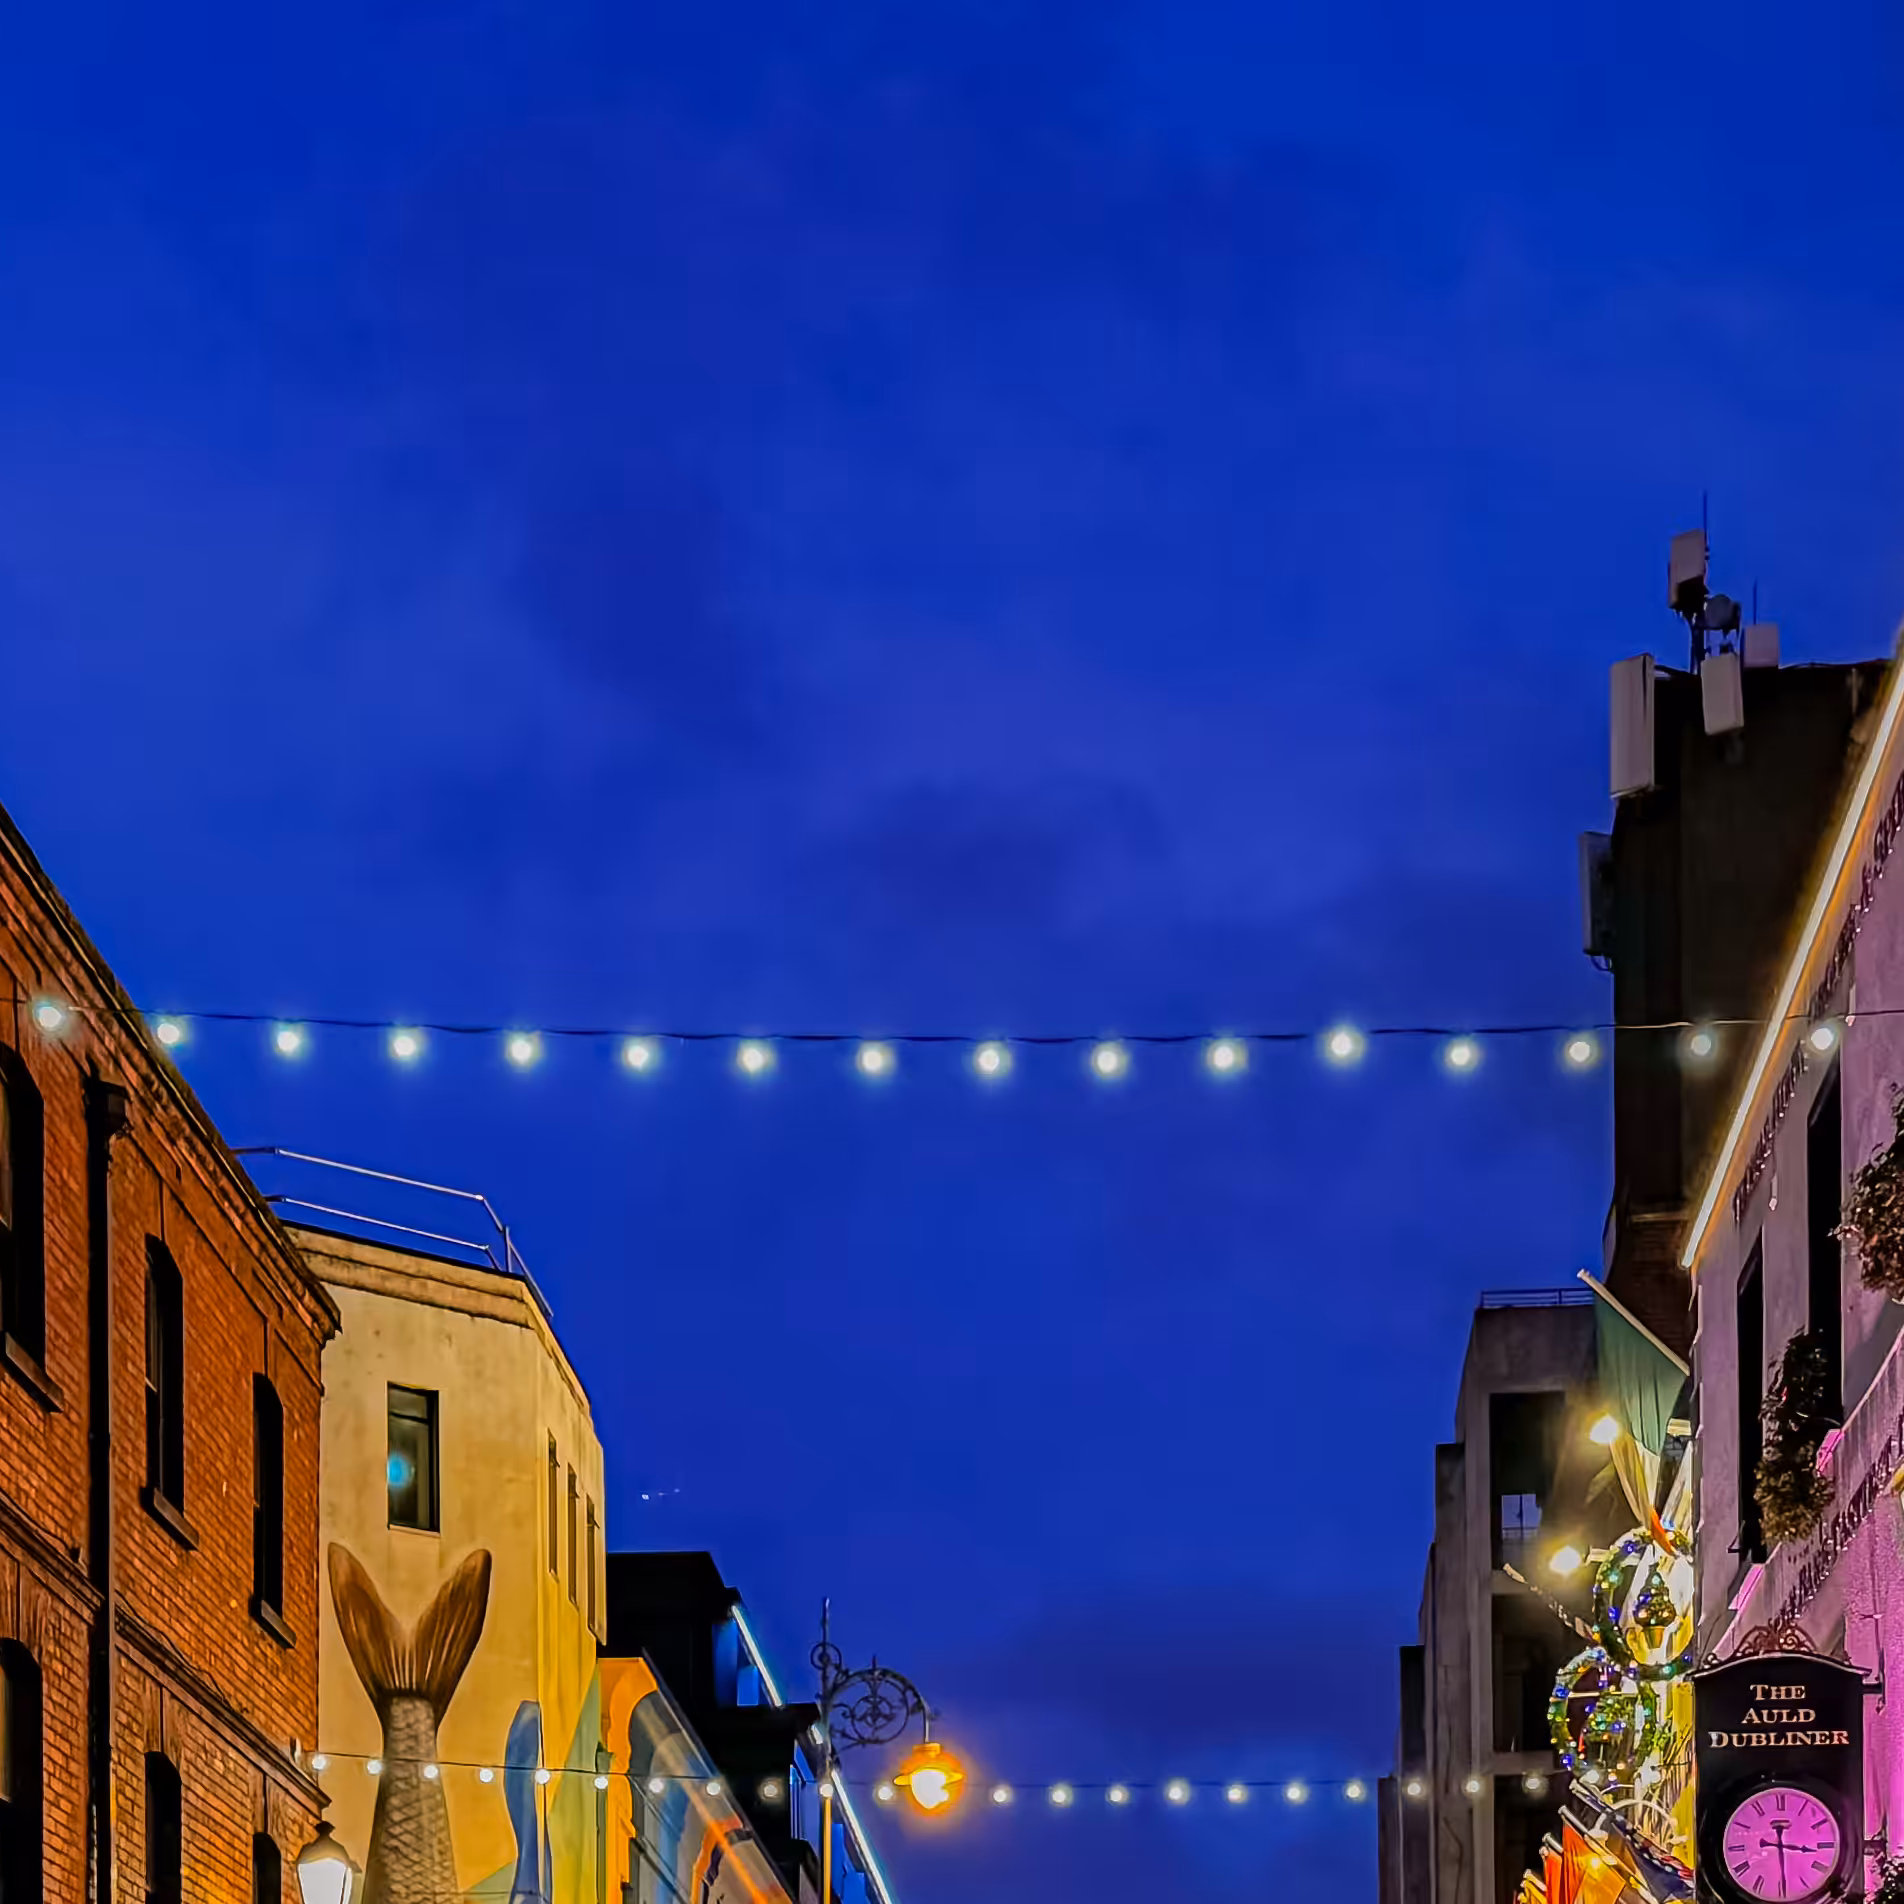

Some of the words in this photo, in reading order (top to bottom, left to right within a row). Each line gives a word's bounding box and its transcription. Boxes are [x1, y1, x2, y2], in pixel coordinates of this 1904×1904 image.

[1750, 1684, 1806, 1701] THE
[1741, 1708, 1817, 1725] AULD
[1707, 1730, 1850, 1749] DUBLINER
